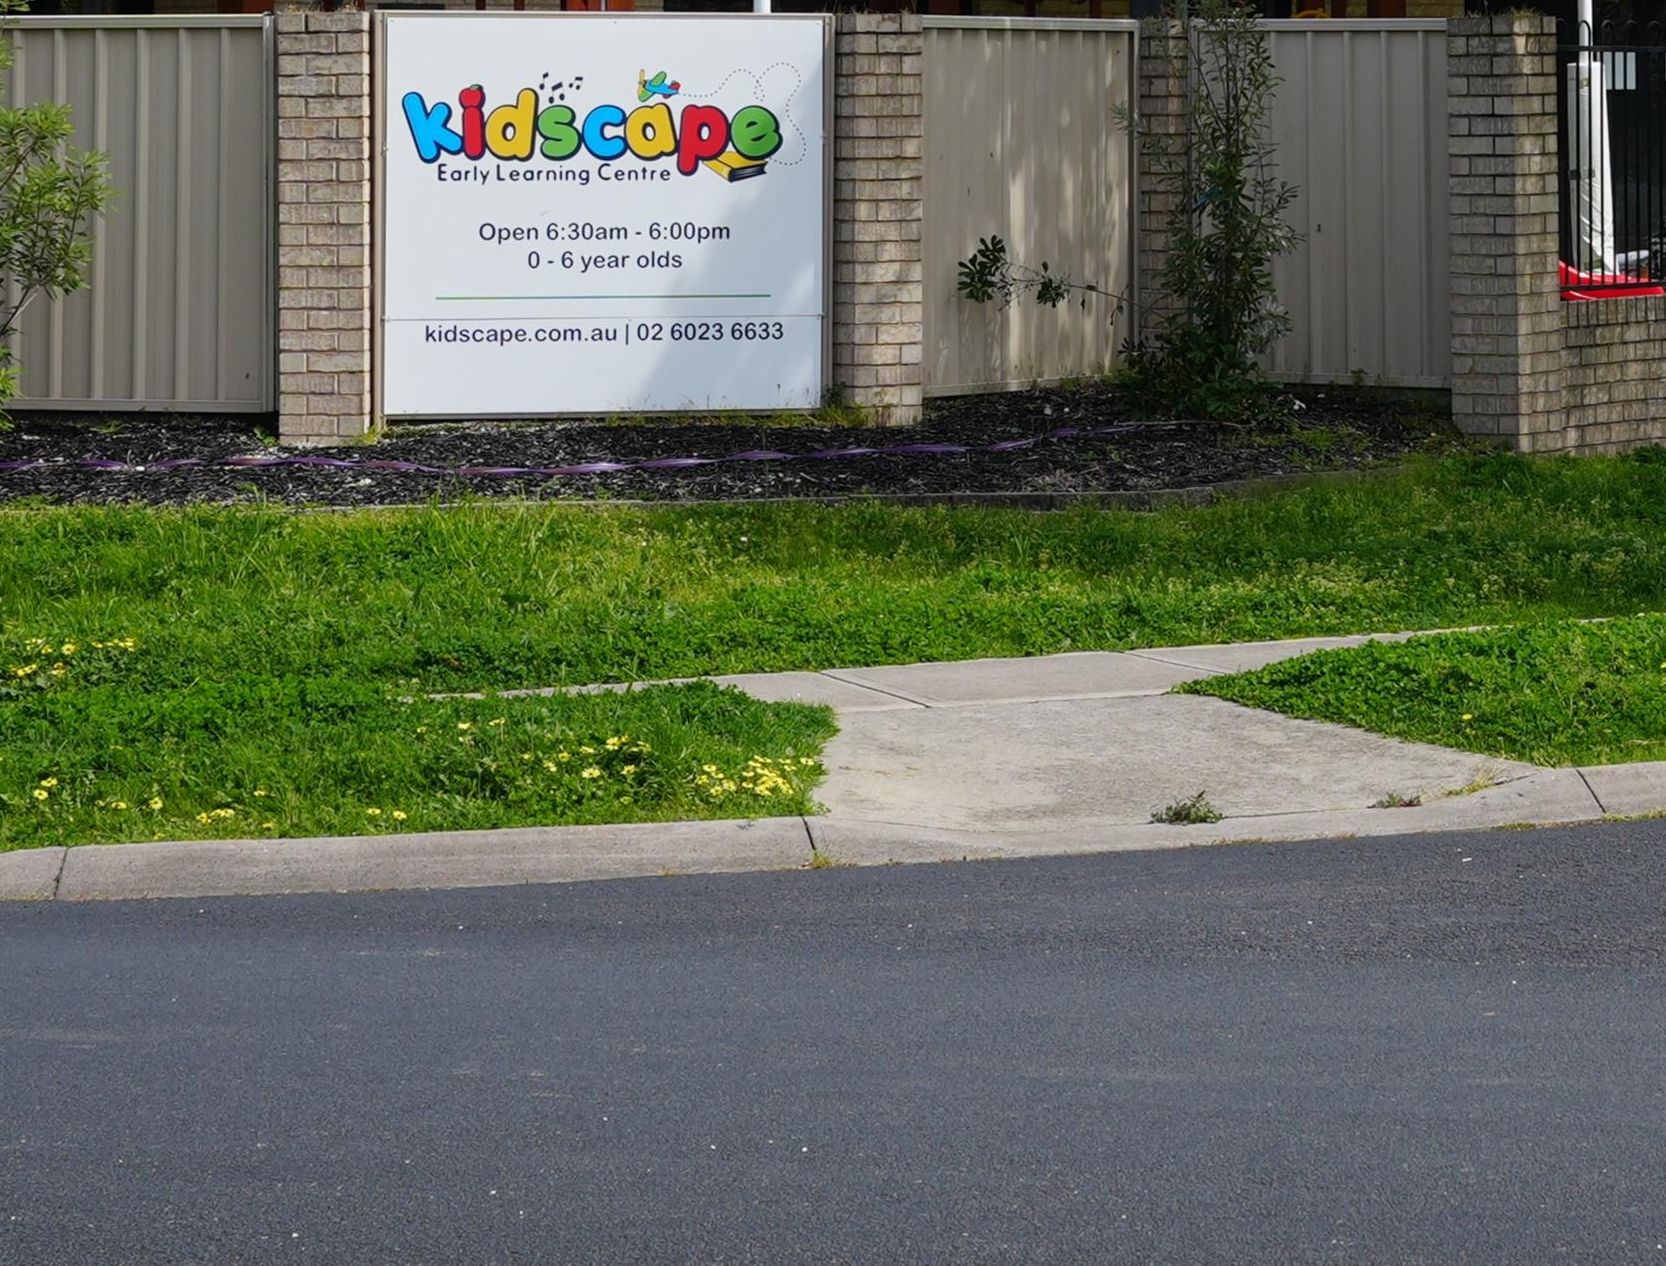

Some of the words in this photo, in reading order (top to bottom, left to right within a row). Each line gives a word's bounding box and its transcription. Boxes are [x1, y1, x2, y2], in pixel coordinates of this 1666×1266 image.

[402, 84, 783, 177] kidscape
[437, 163, 490, 185] Early
[496, 164, 590, 185] Learning
[597, 163, 671, 181] Centre
[478, 222, 539, 244] Open
[546, 222, 628, 241] 6:30am
[648, 221, 731, 244] 6:00pm
[527, 250, 541, 269] 0
[560, 250, 574, 269] 6
[580, 253, 630, 273] year
[636, 250, 683, 269] olds
[424, 324, 618, 346] kidscape.com.au
[636, 322, 664, 342] 02
[669, 322, 725, 342] 6023
[730, 322, 784, 341] 6633
